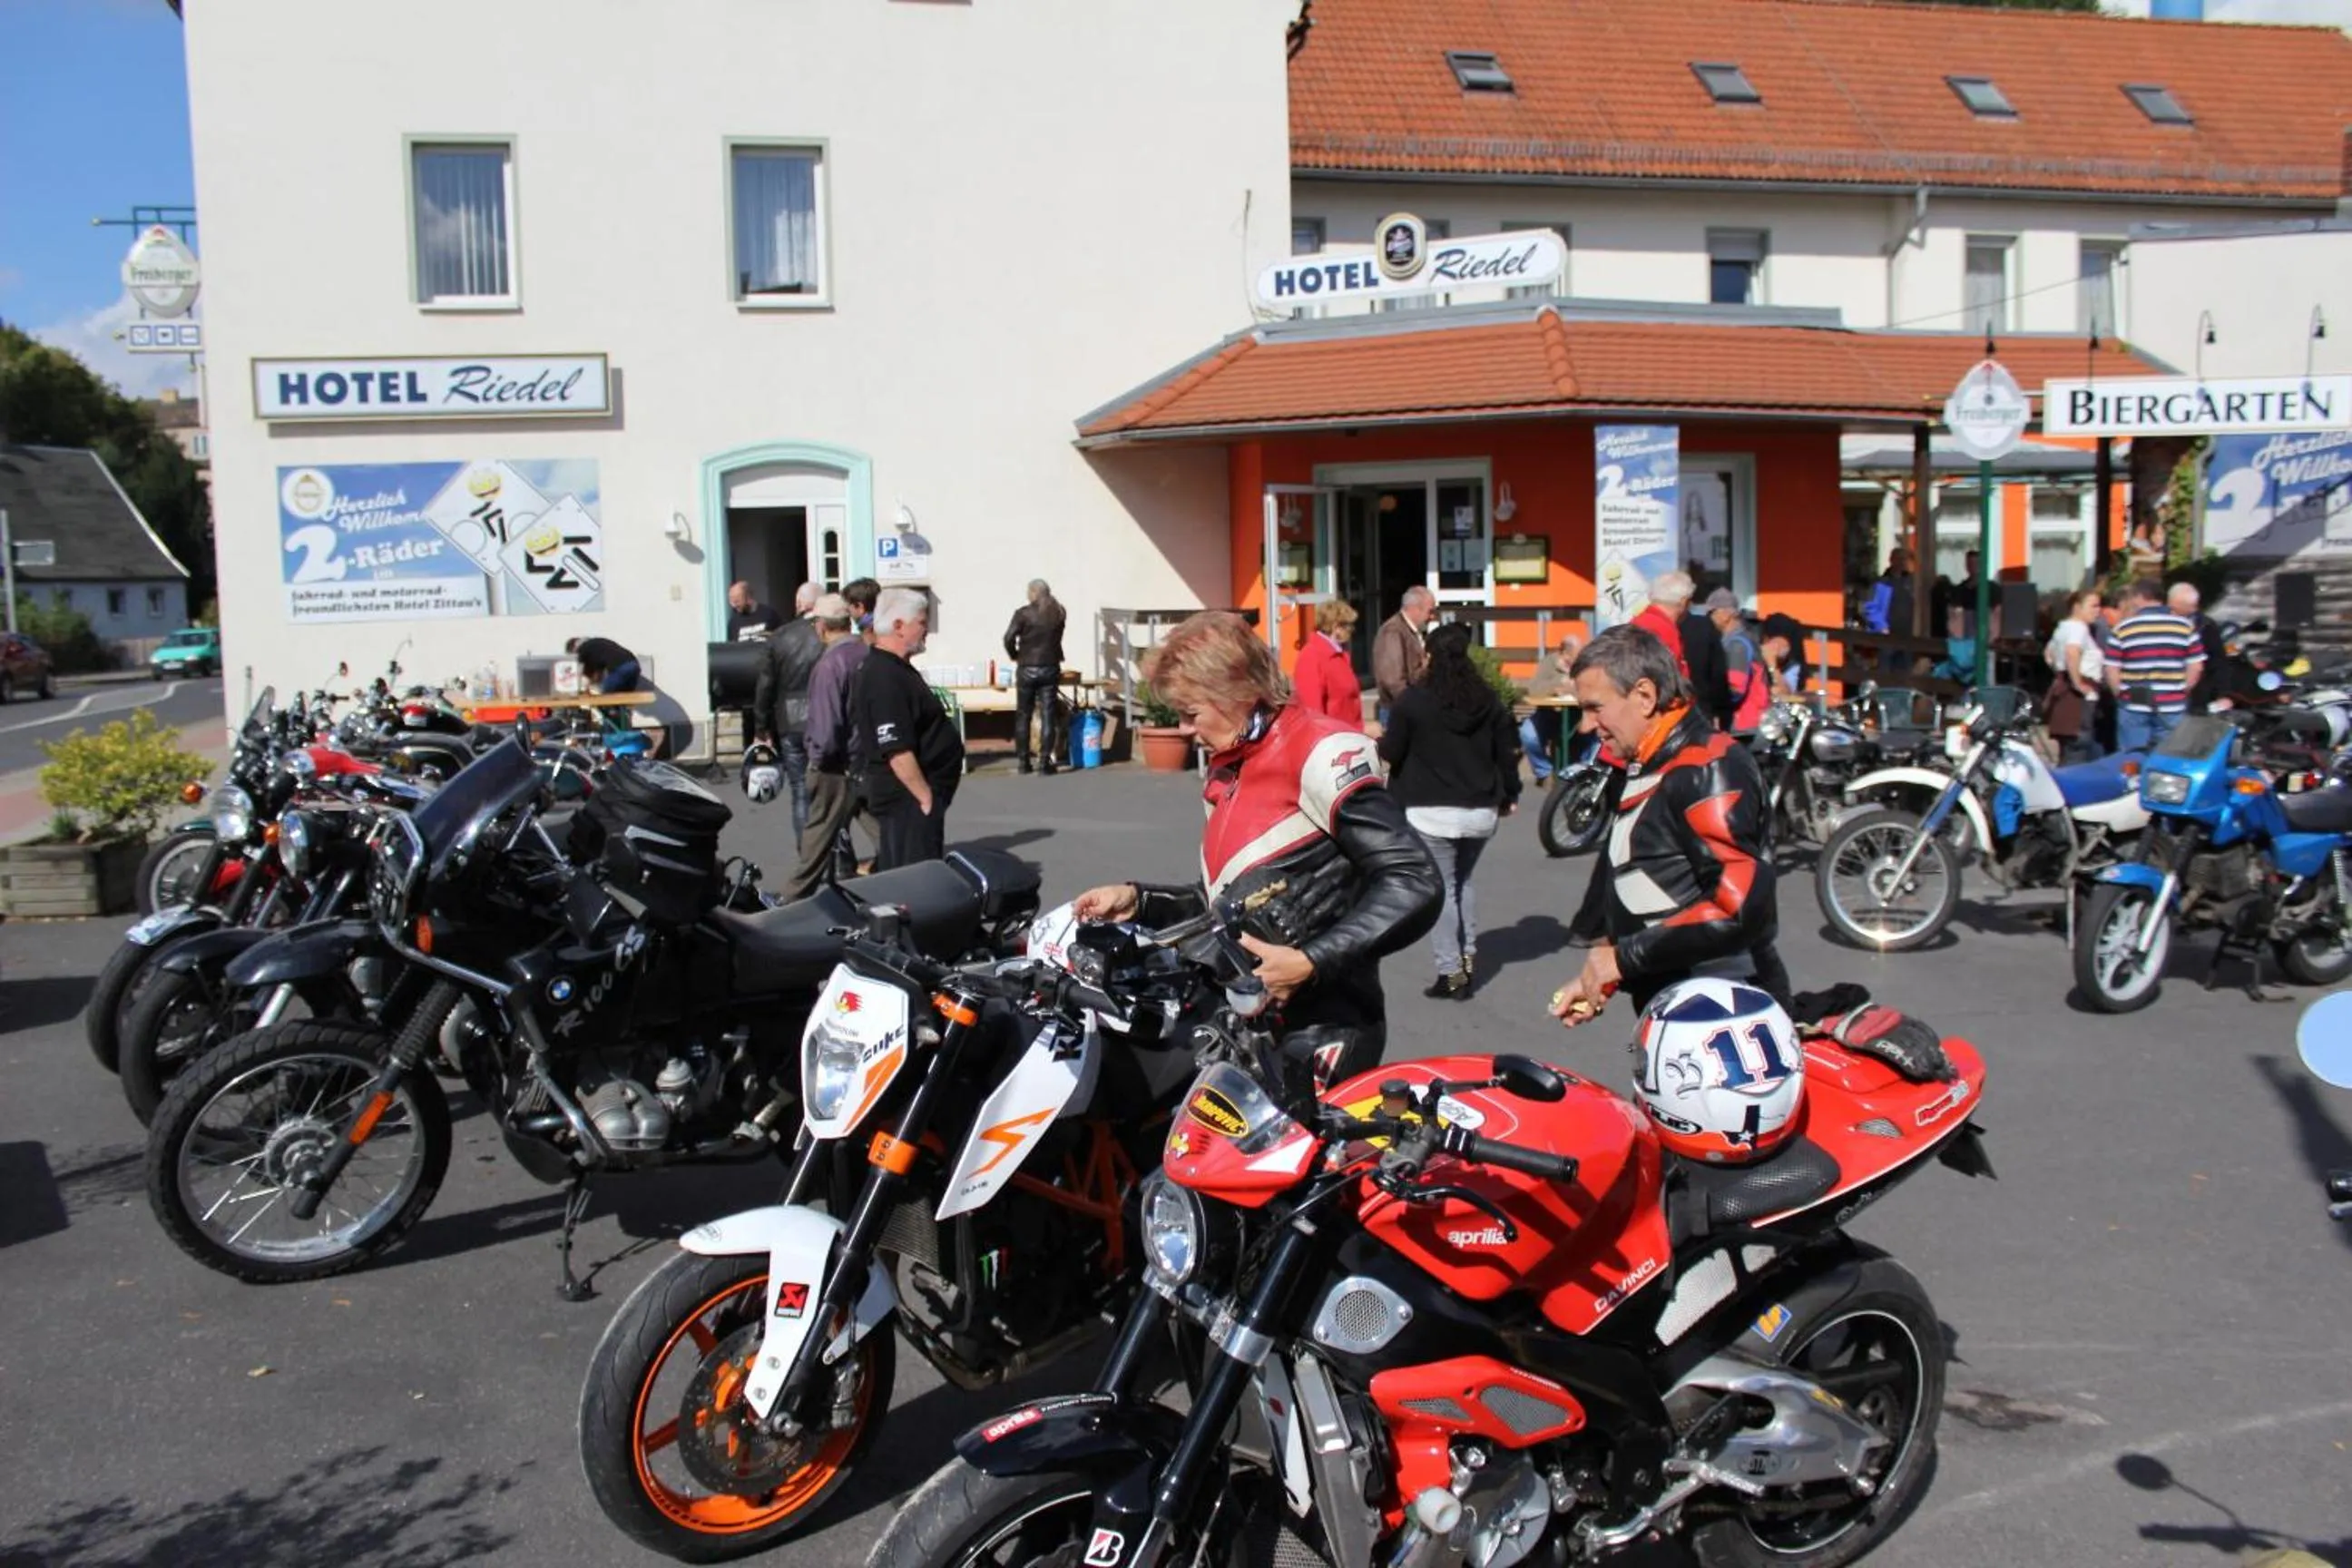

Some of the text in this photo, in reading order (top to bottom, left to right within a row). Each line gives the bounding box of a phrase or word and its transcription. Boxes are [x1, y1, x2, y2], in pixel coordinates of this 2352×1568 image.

[1274, 242, 1538, 296] HOTEL Riedel
[278, 365, 584, 405] HOTEL Riedel
[2069, 389, 2332, 425] BIERGARTEN
[320, 488, 407, 522] Herzlich
[882, 540, 896, 555] P
[394, 599, 428, 610] Hotel
[1705, 1022, 1791, 1090] 11
[1447, 1228, 1507, 1249] aprilia
